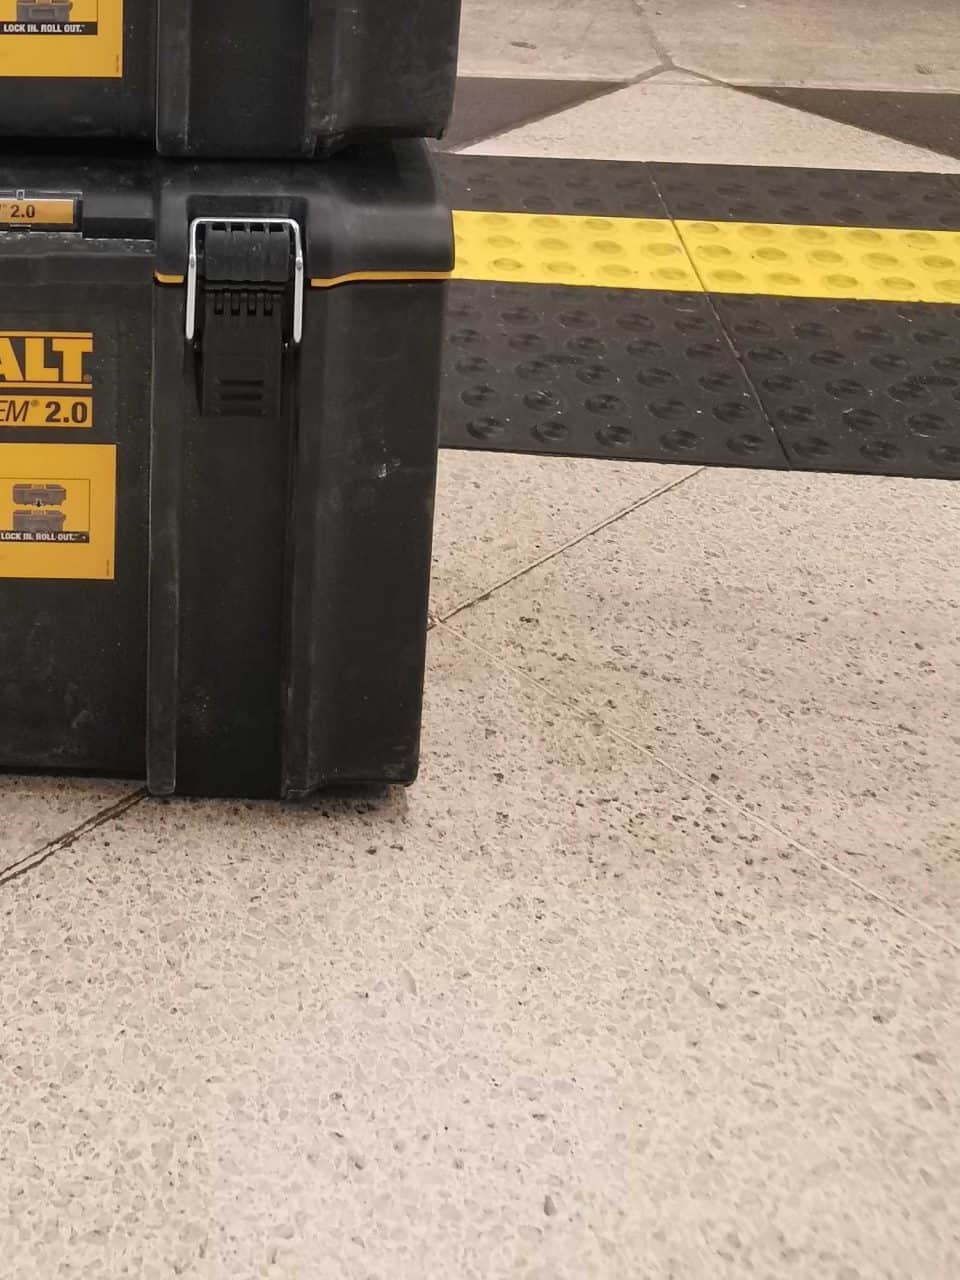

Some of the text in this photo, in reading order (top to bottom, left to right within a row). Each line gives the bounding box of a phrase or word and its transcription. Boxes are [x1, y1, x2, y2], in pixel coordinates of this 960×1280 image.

[3, 24, 26, 33] LOCK
[40, 24, 63, 33] ROLL
[10, 204, 36, 219] 2.0
[44, 401, 88, 424] 2.0
[0, 532, 22, 541] LOCK
